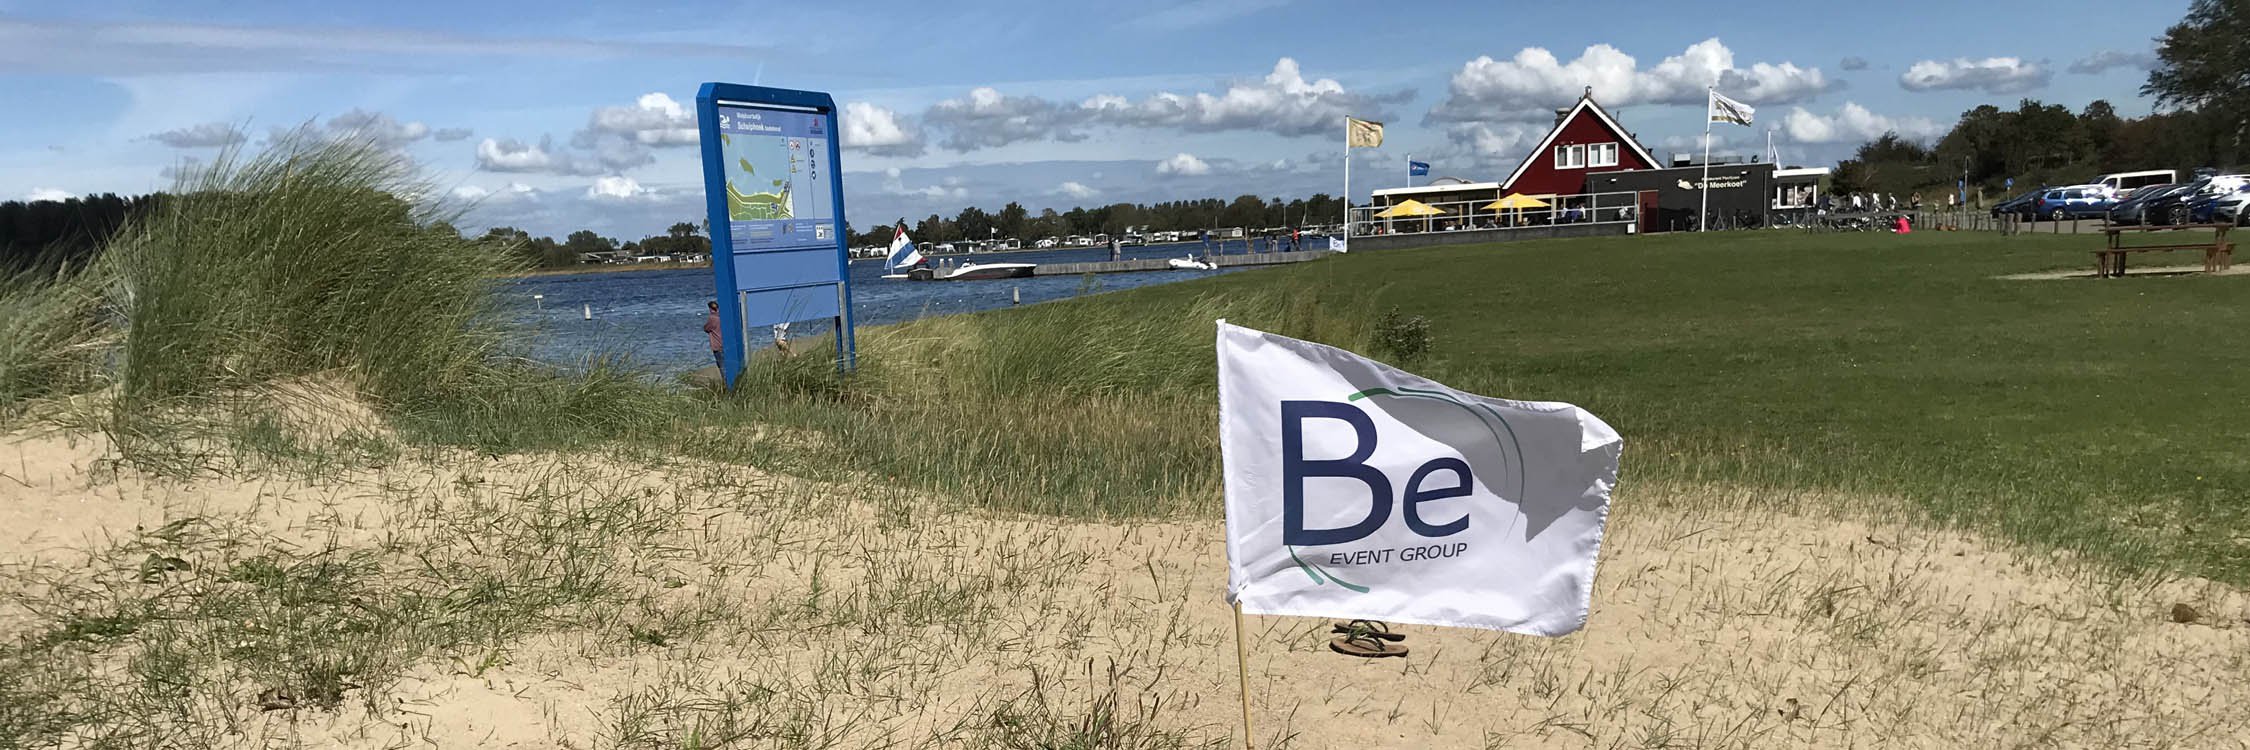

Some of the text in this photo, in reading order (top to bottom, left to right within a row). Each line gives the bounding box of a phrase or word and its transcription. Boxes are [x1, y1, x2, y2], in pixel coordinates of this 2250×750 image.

[1281, 400, 1473, 546] Be
[1330, 543, 1467, 565] EVENT GROUP
